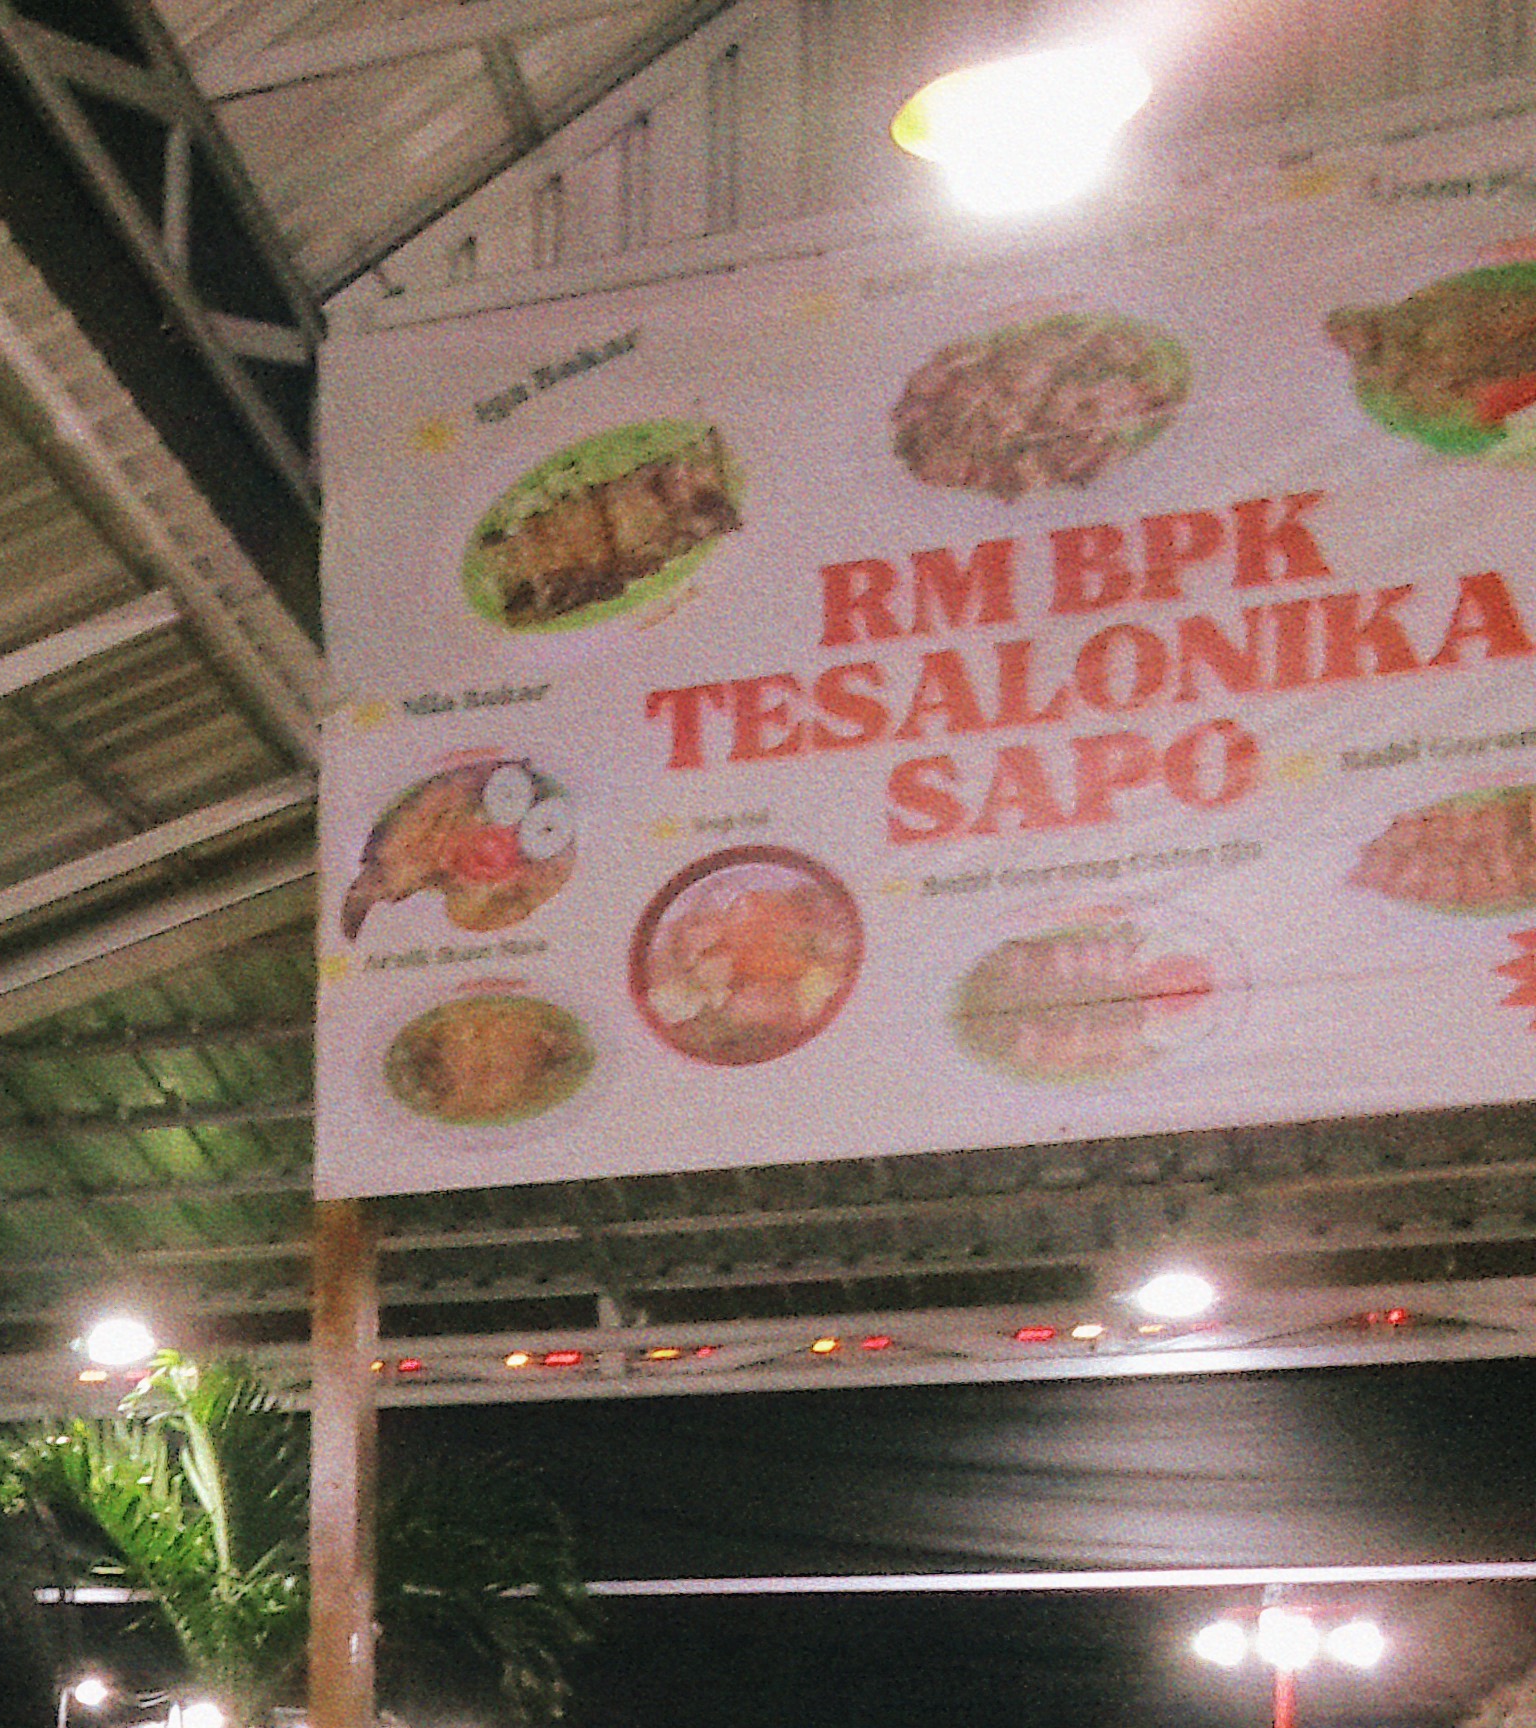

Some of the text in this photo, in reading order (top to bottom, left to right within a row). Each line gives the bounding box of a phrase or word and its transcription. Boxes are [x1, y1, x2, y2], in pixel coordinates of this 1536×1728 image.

[820, 490, 1333, 648] RM BPK
[646, 572, 1534, 770] TESALONIKA
[884, 718, 1262, 846] SAPO
